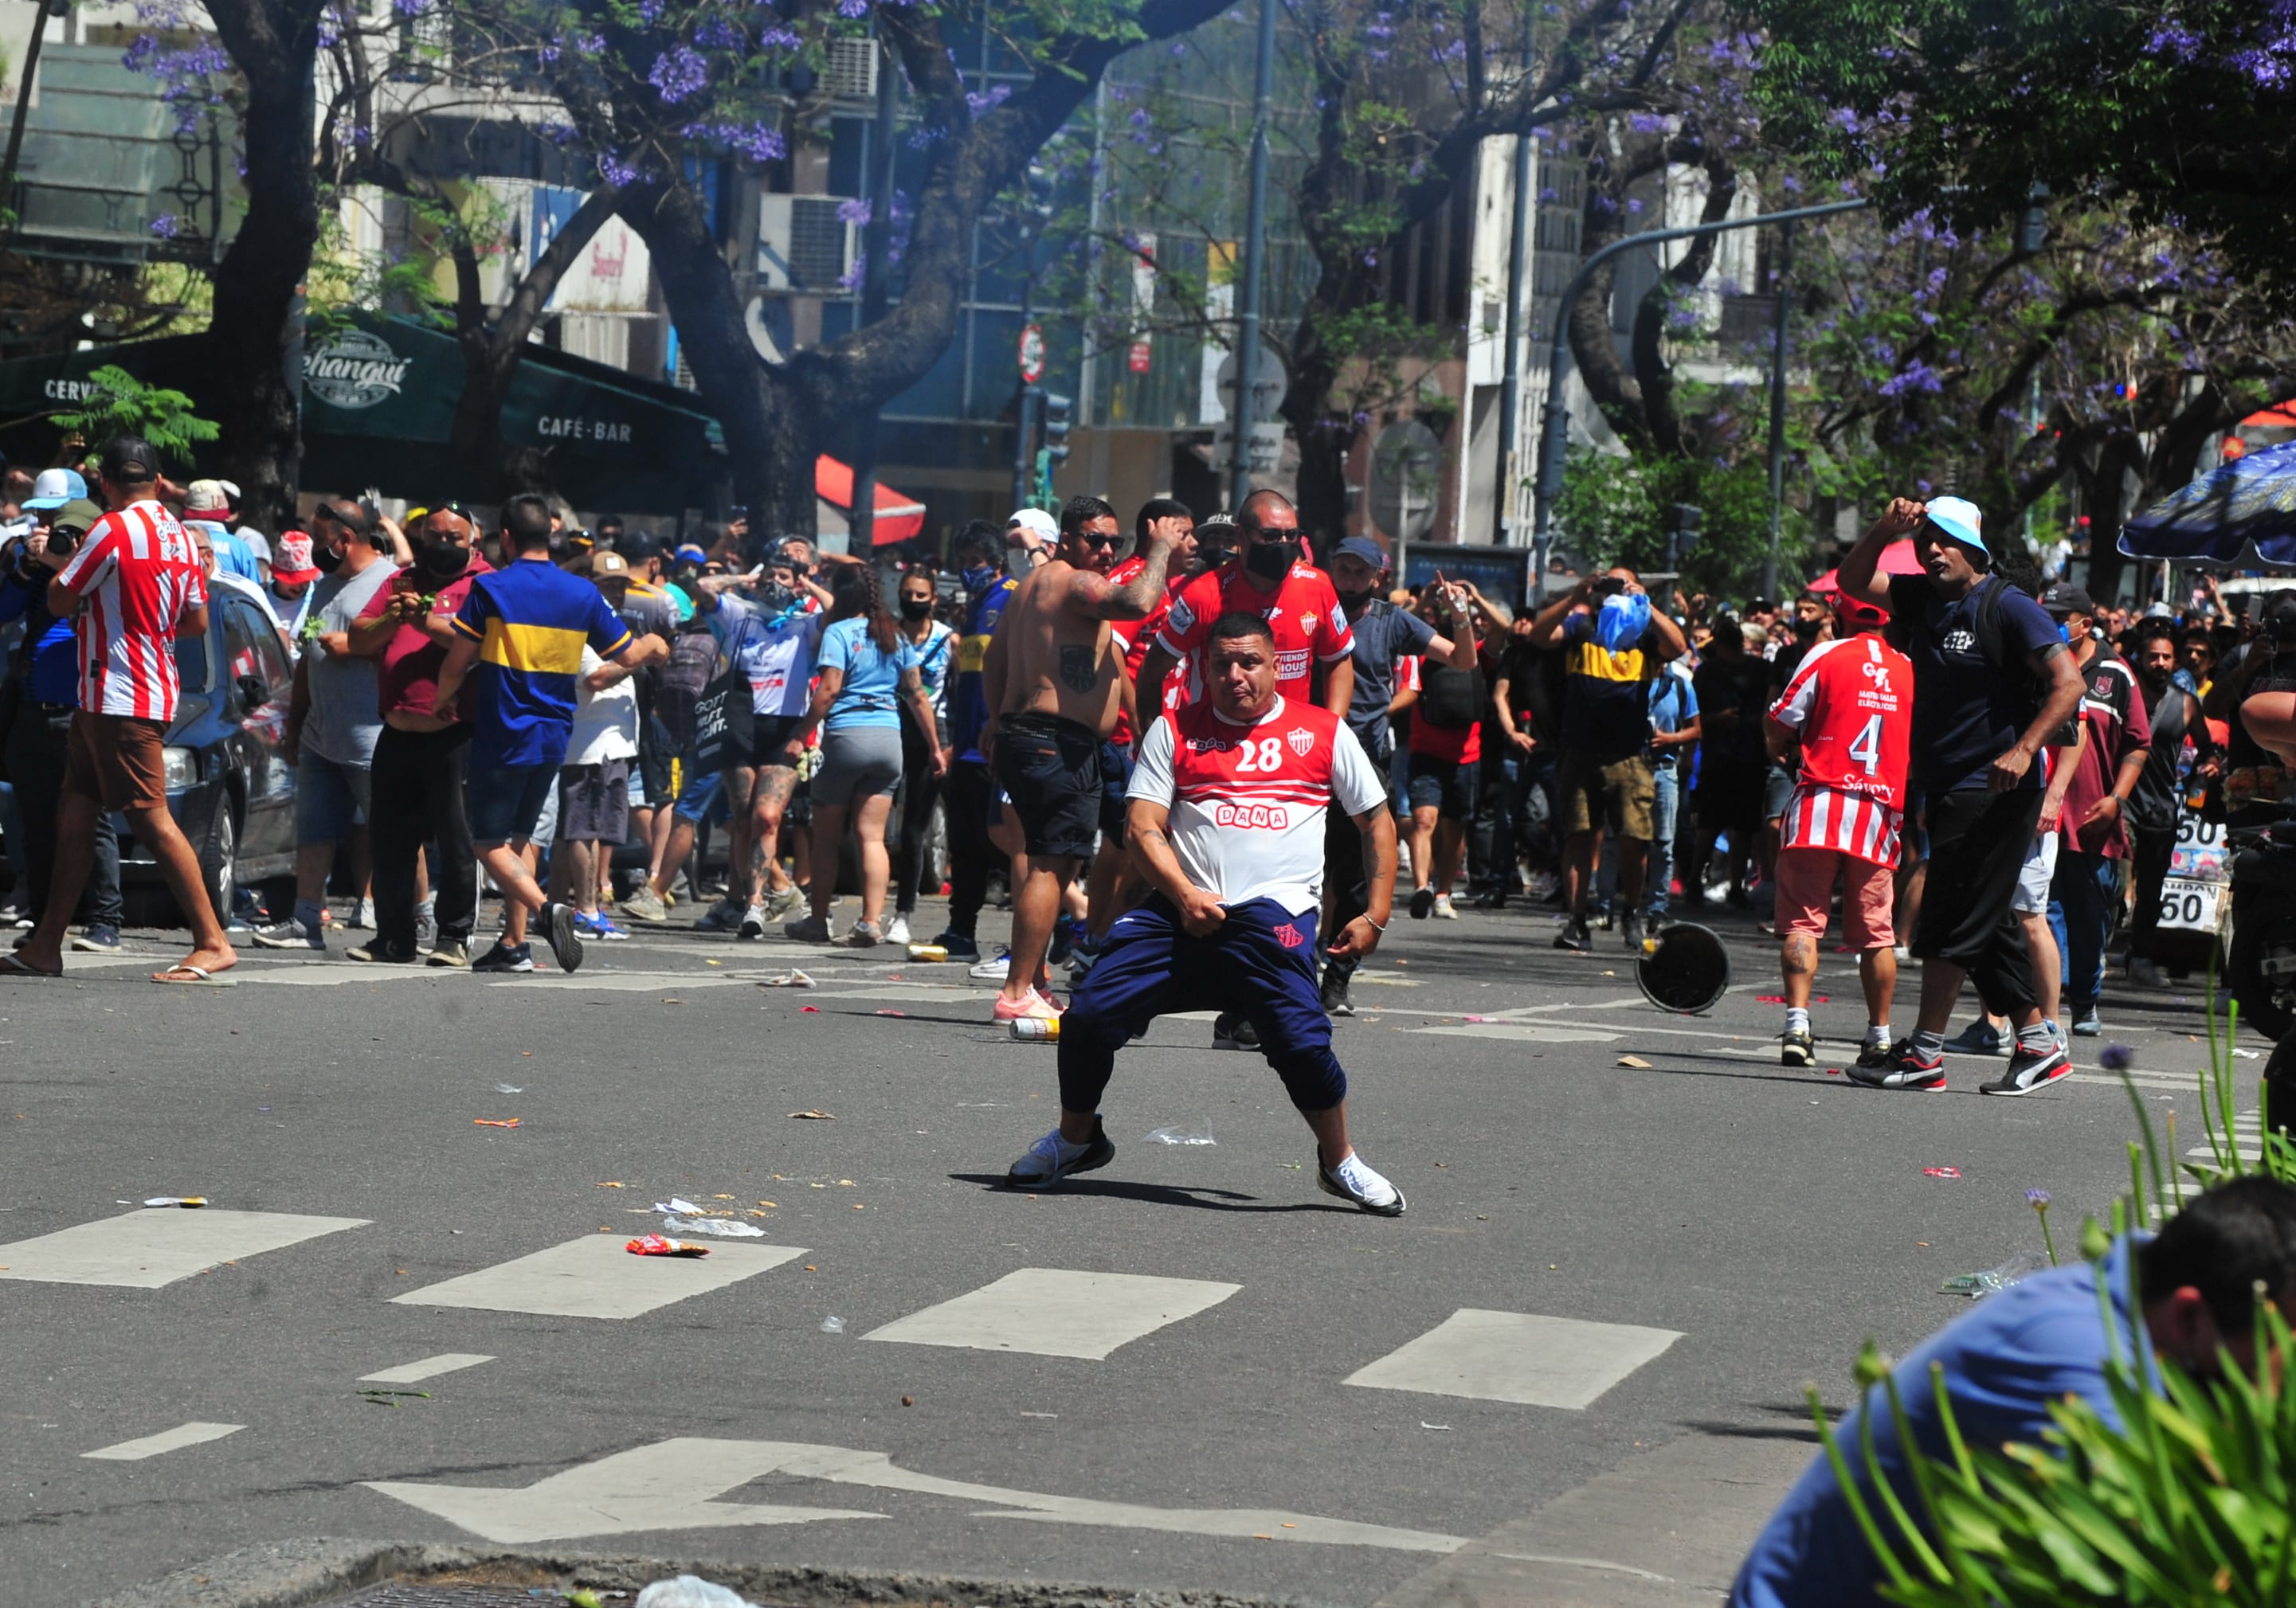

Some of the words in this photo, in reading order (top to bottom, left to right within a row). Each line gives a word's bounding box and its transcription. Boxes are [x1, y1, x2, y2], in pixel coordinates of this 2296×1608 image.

[538, 416, 584, 439] CAFÉ
[594, 421, 631, 442] BAR
[1236, 737, 1283, 773] 28
[1848, 714, 1884, 778] 4
[1220, 807, 1285, 827] DANA
[2176, 814, 2217, 845] 50
[2160, 893, 2203, 923] 50
